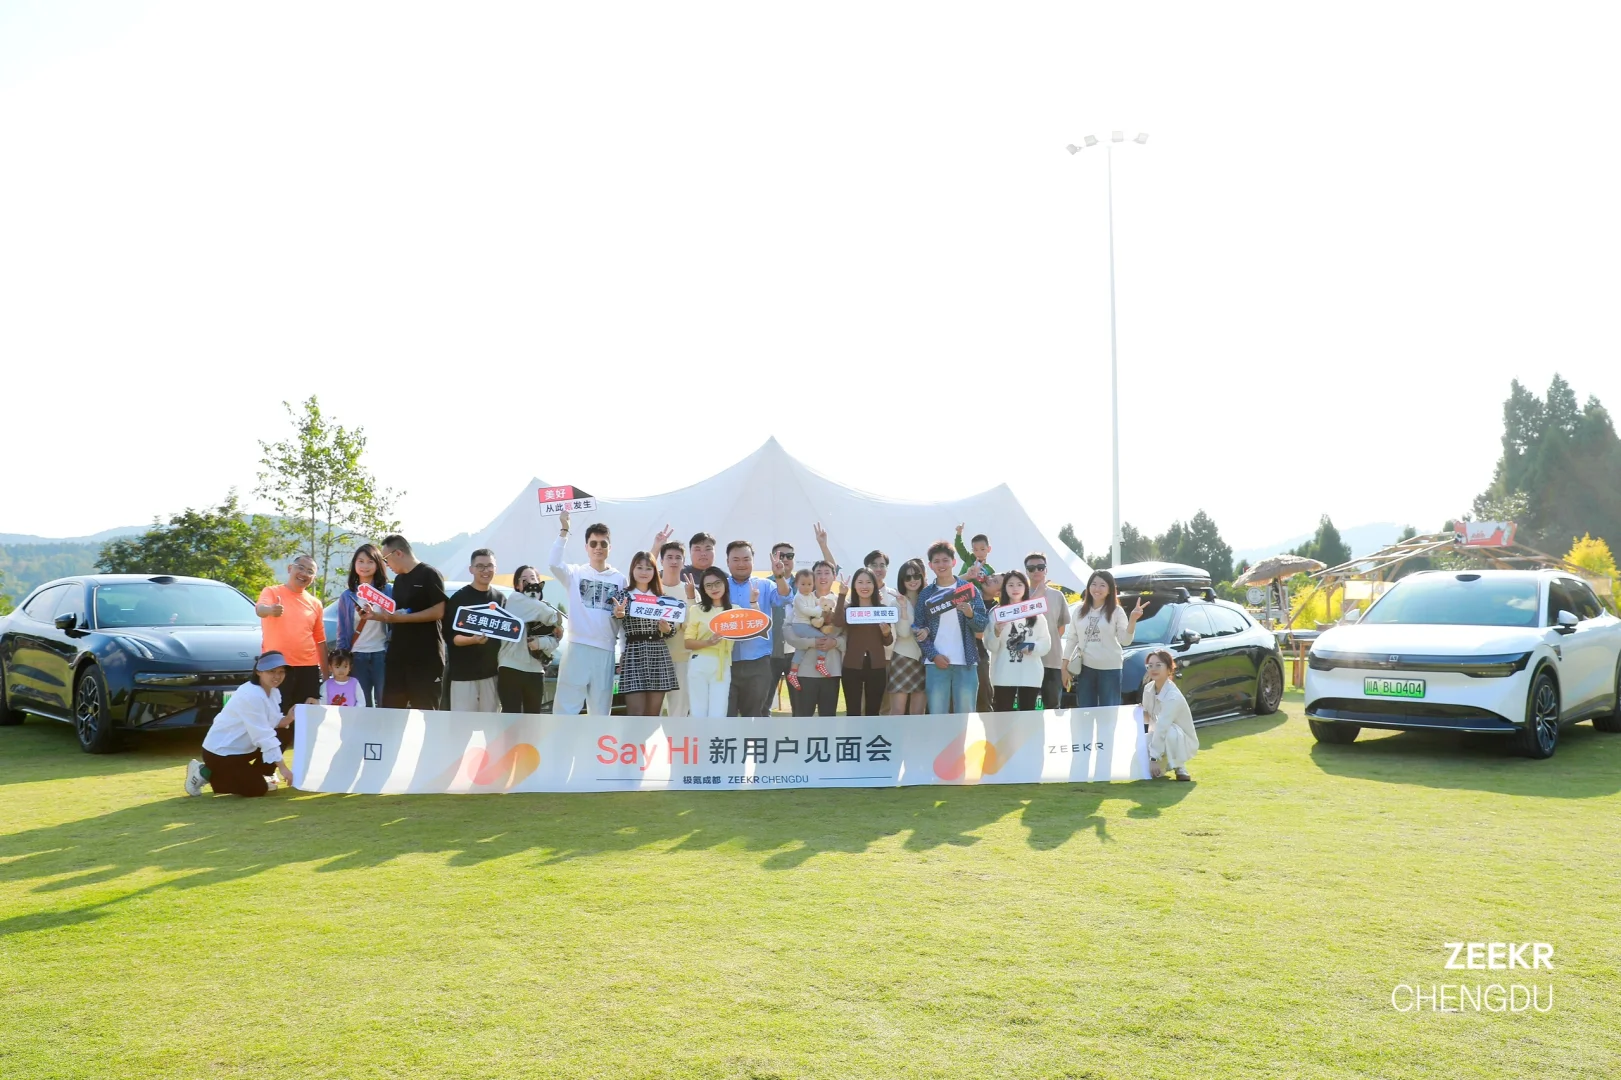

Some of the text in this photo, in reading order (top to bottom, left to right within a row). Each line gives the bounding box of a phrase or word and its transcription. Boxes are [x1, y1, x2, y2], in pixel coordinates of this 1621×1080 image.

[545, 489, 565, 500] 美好
[635, 607, 682, 619] 欢迎新Z客
[466, 614, 512, 632] 经典时氪
[597, 734, 892, 771] Say Hi 新用户见面会
[1048, 742, 1104, 754] ZEEKR
[683, 775, 809, 785] 极氪成都 ZEEKR CHENGDU
